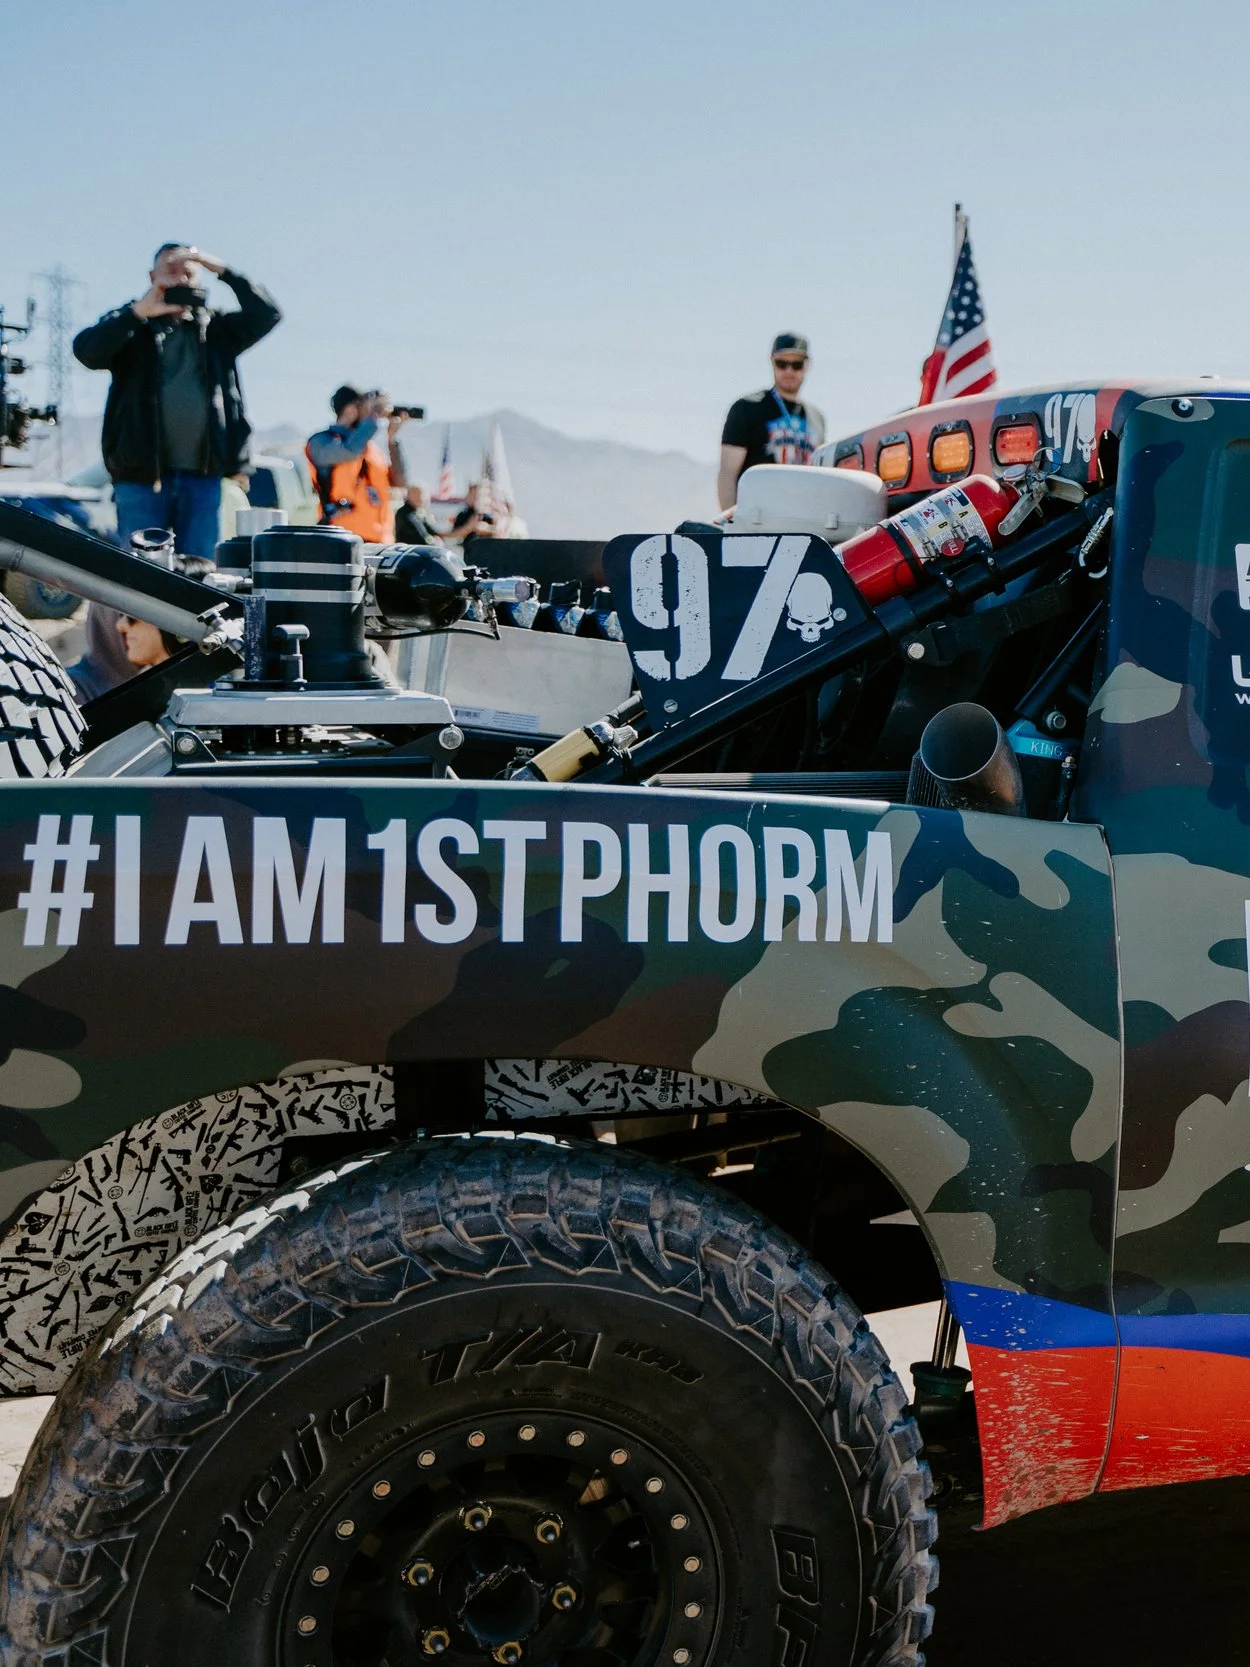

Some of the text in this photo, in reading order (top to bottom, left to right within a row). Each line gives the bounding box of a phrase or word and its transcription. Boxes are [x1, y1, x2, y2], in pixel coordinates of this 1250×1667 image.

[1044, 393, 1087, 464] 97
[630, 534, 812, 682] 97
[1030, 741, 1064, 757] KING
[561, 822, 893, 944] PHORM
